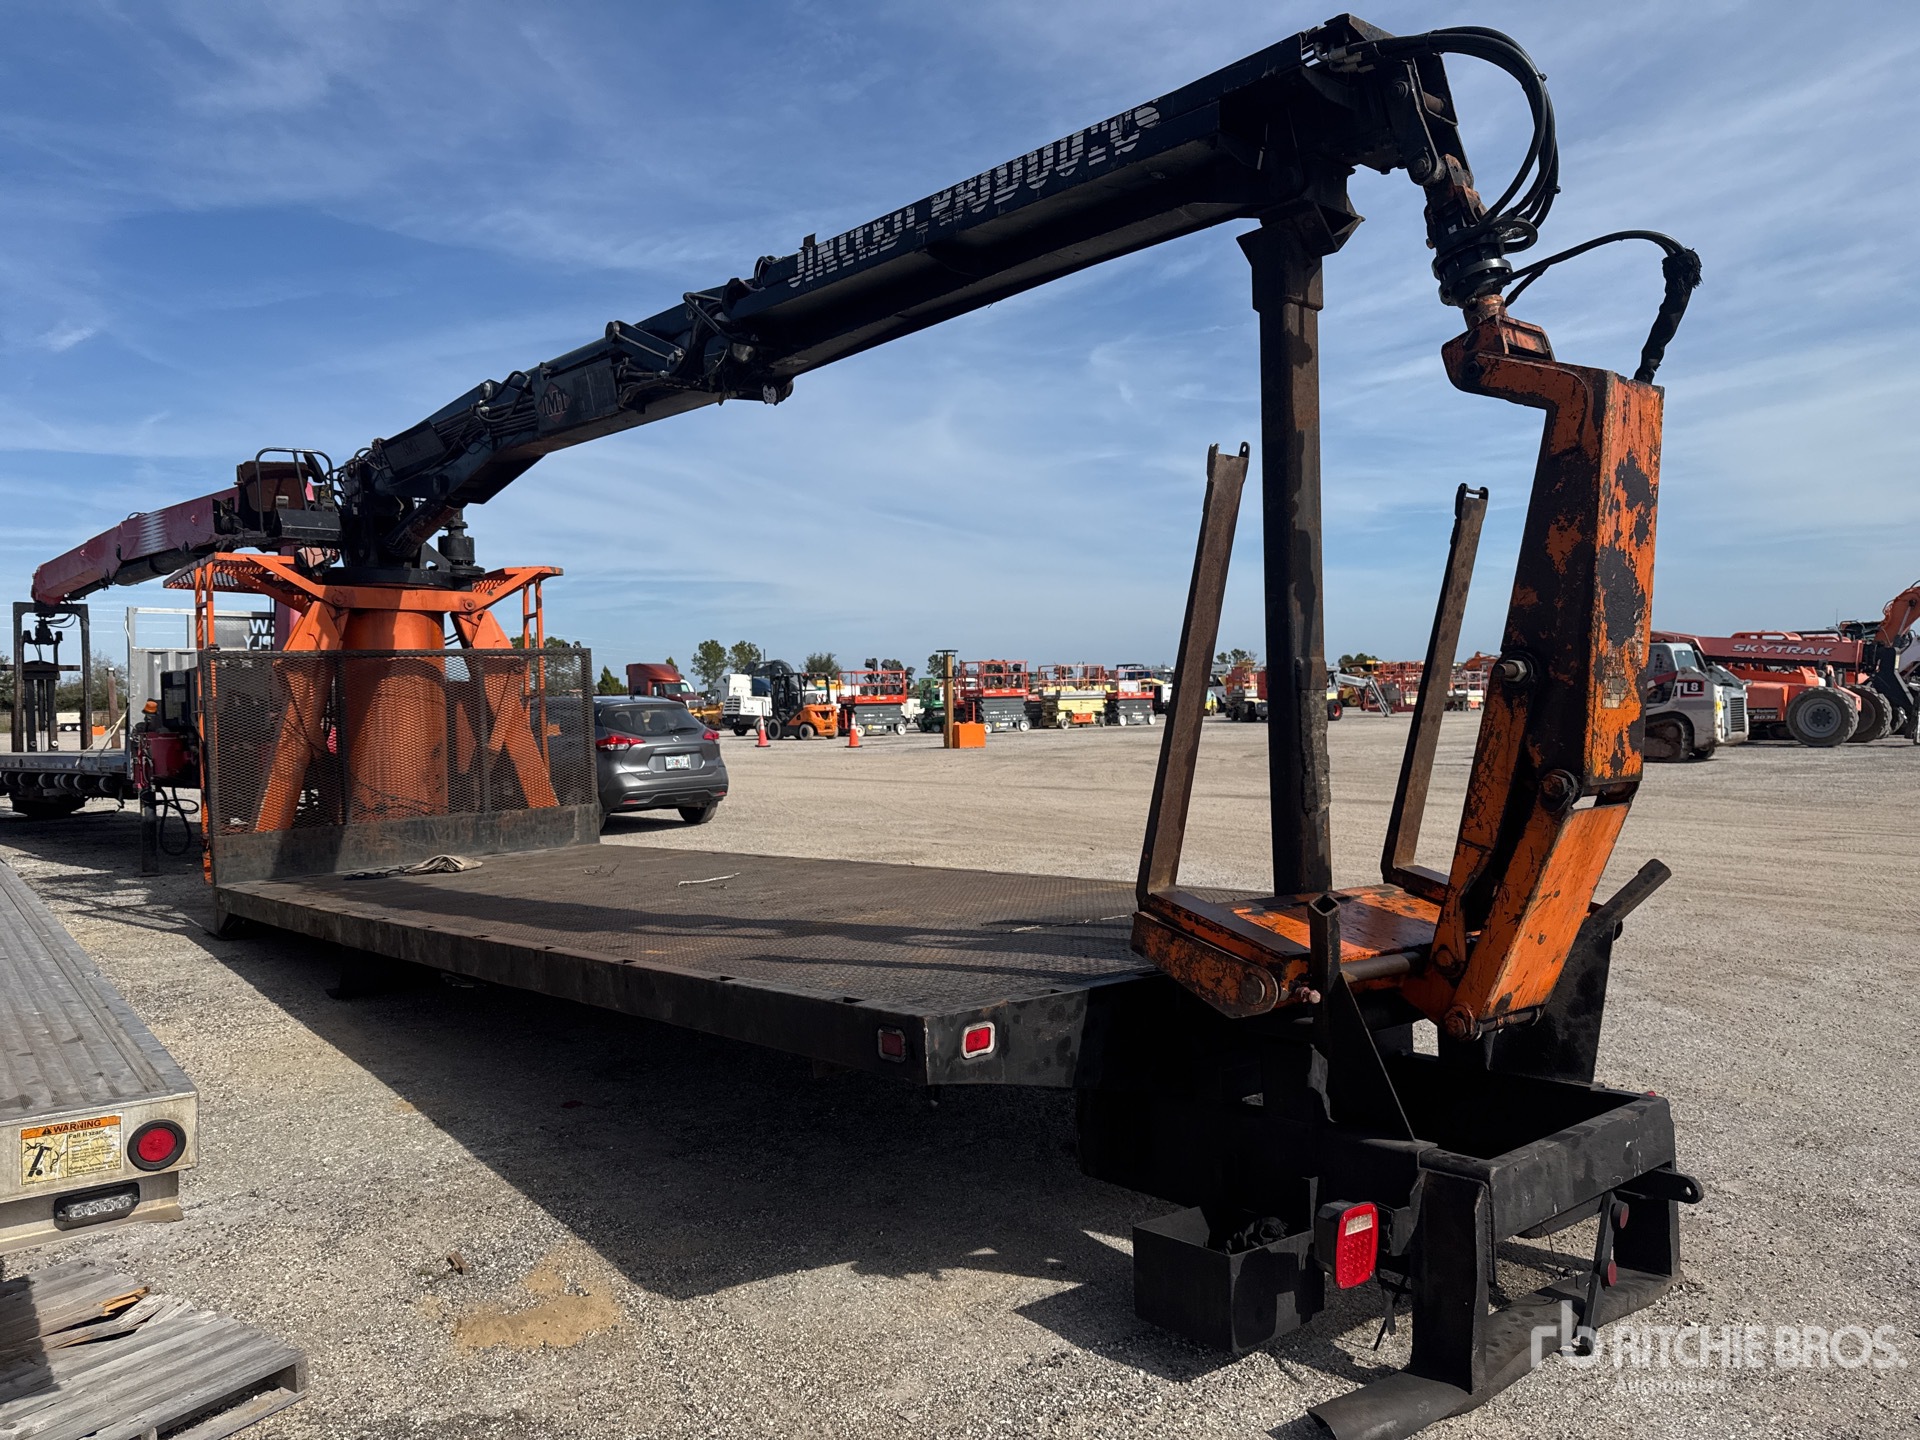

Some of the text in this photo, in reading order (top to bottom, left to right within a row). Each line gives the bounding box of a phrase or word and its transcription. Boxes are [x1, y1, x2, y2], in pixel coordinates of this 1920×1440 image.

[1731, 643, 1834, 656] SKYTRAK
[53, 1119, 102, 1133] WARNING
[68, 1131, 81, 1140] Fall
